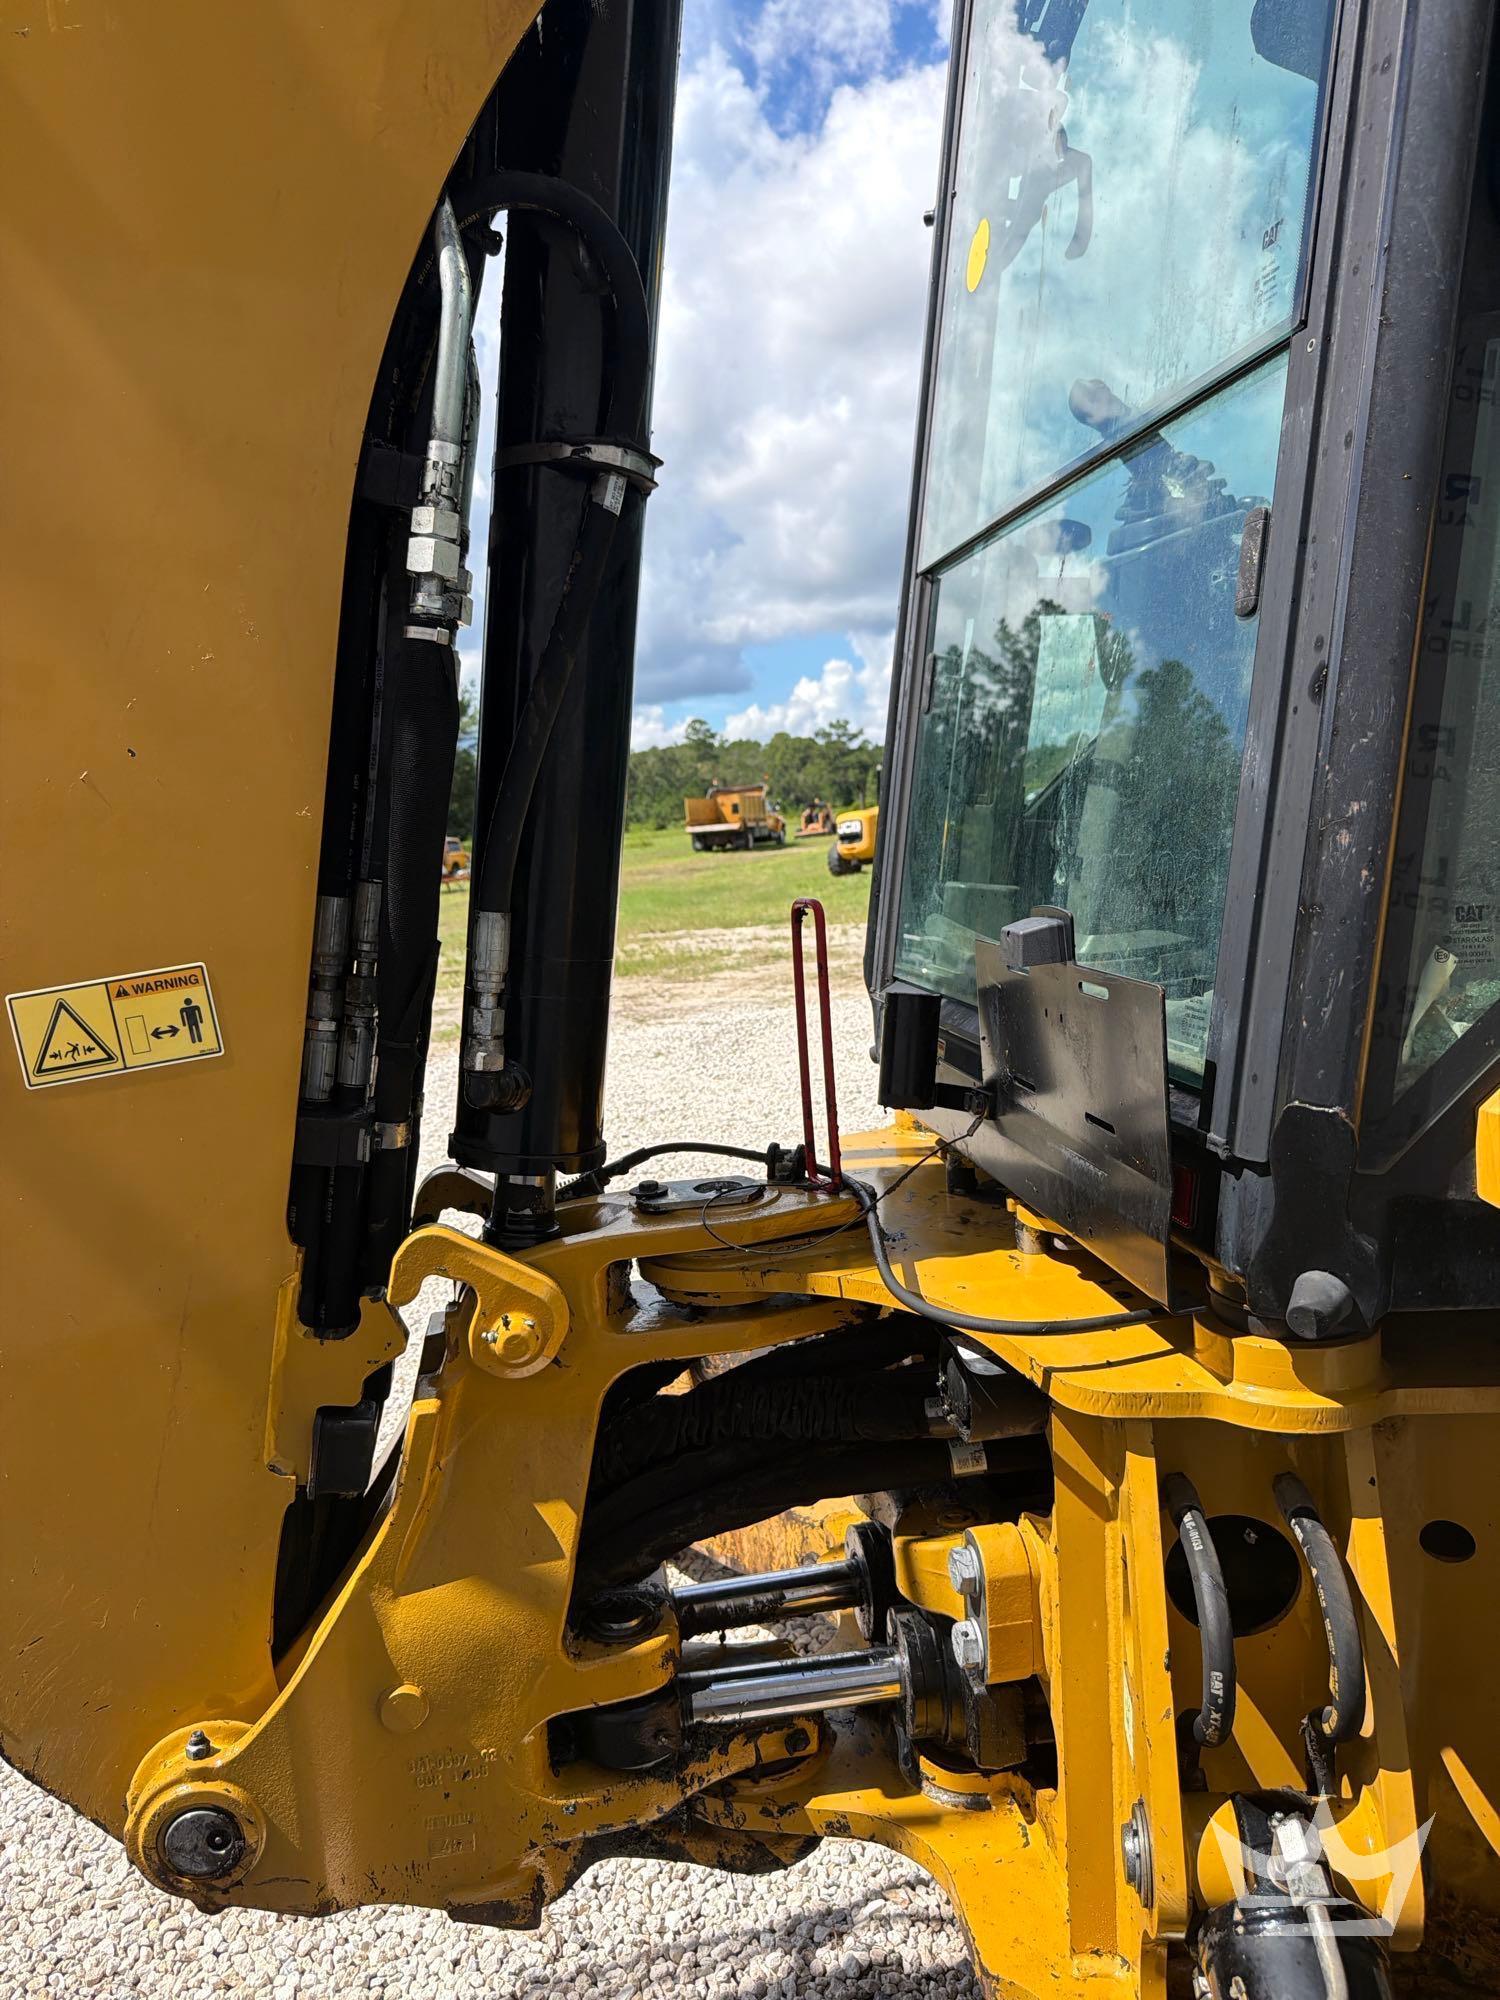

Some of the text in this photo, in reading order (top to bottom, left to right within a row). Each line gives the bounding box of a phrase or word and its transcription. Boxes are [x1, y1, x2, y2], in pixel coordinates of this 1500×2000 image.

[1262, 221, 1281, 250] CAT
[1455, 905, 1484, 923] CAT
[131, 974, 200, 995] WARNING
[1210, 1671, 1224, 1698] CAT
